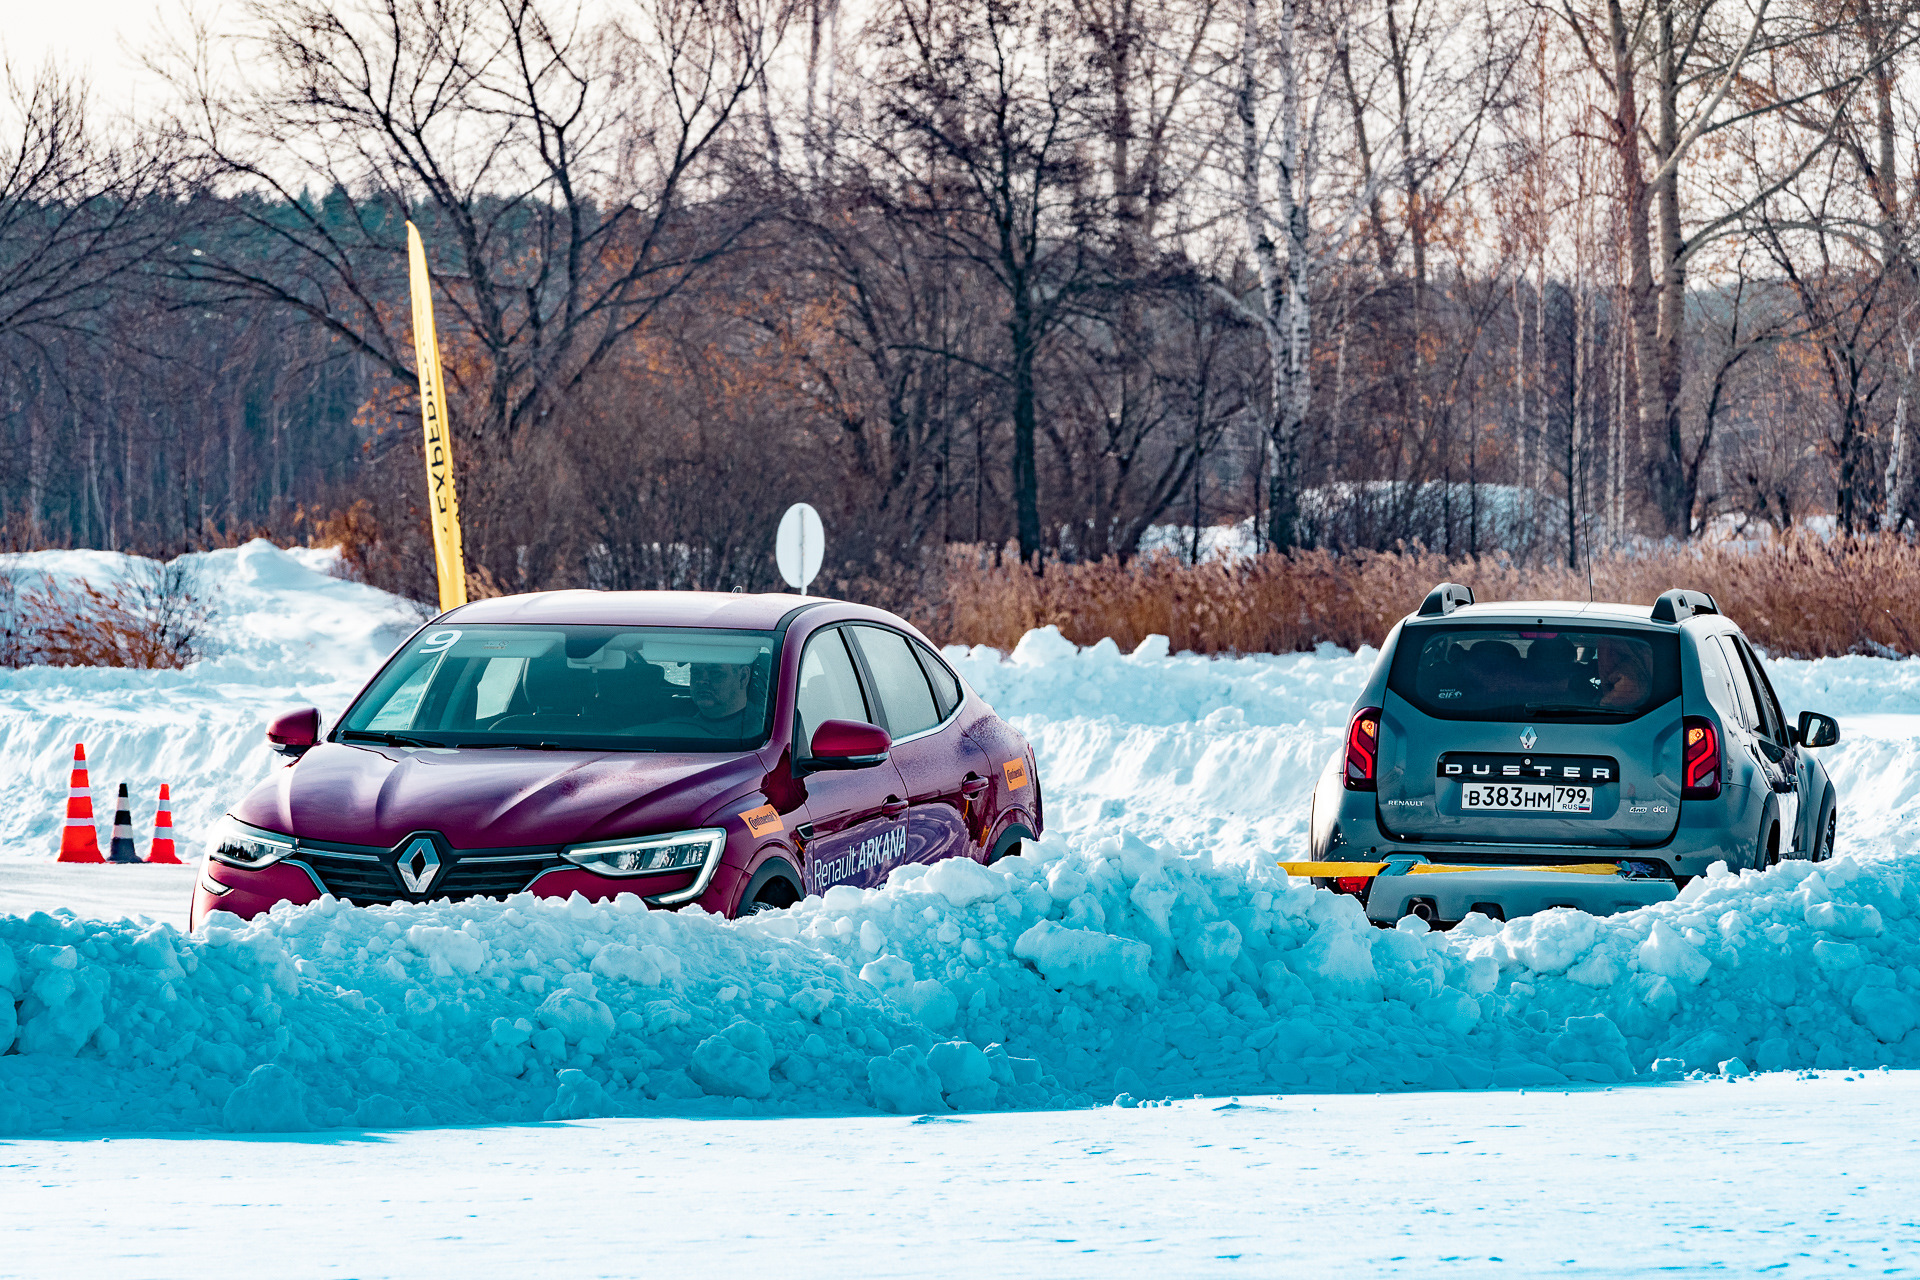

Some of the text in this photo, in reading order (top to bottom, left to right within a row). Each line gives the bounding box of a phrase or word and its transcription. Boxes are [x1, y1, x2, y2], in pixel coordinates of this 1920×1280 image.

[419, 630, 463, 654] 9
[1445, 763, 1610, 779] DUSTER
[1555, 787, 1588, 804] 799
[1652, 805, 1668, 813] dCi
[748, 811, 777, 830] Continental
[814, 825, 906, 890] Renault ARKANA
